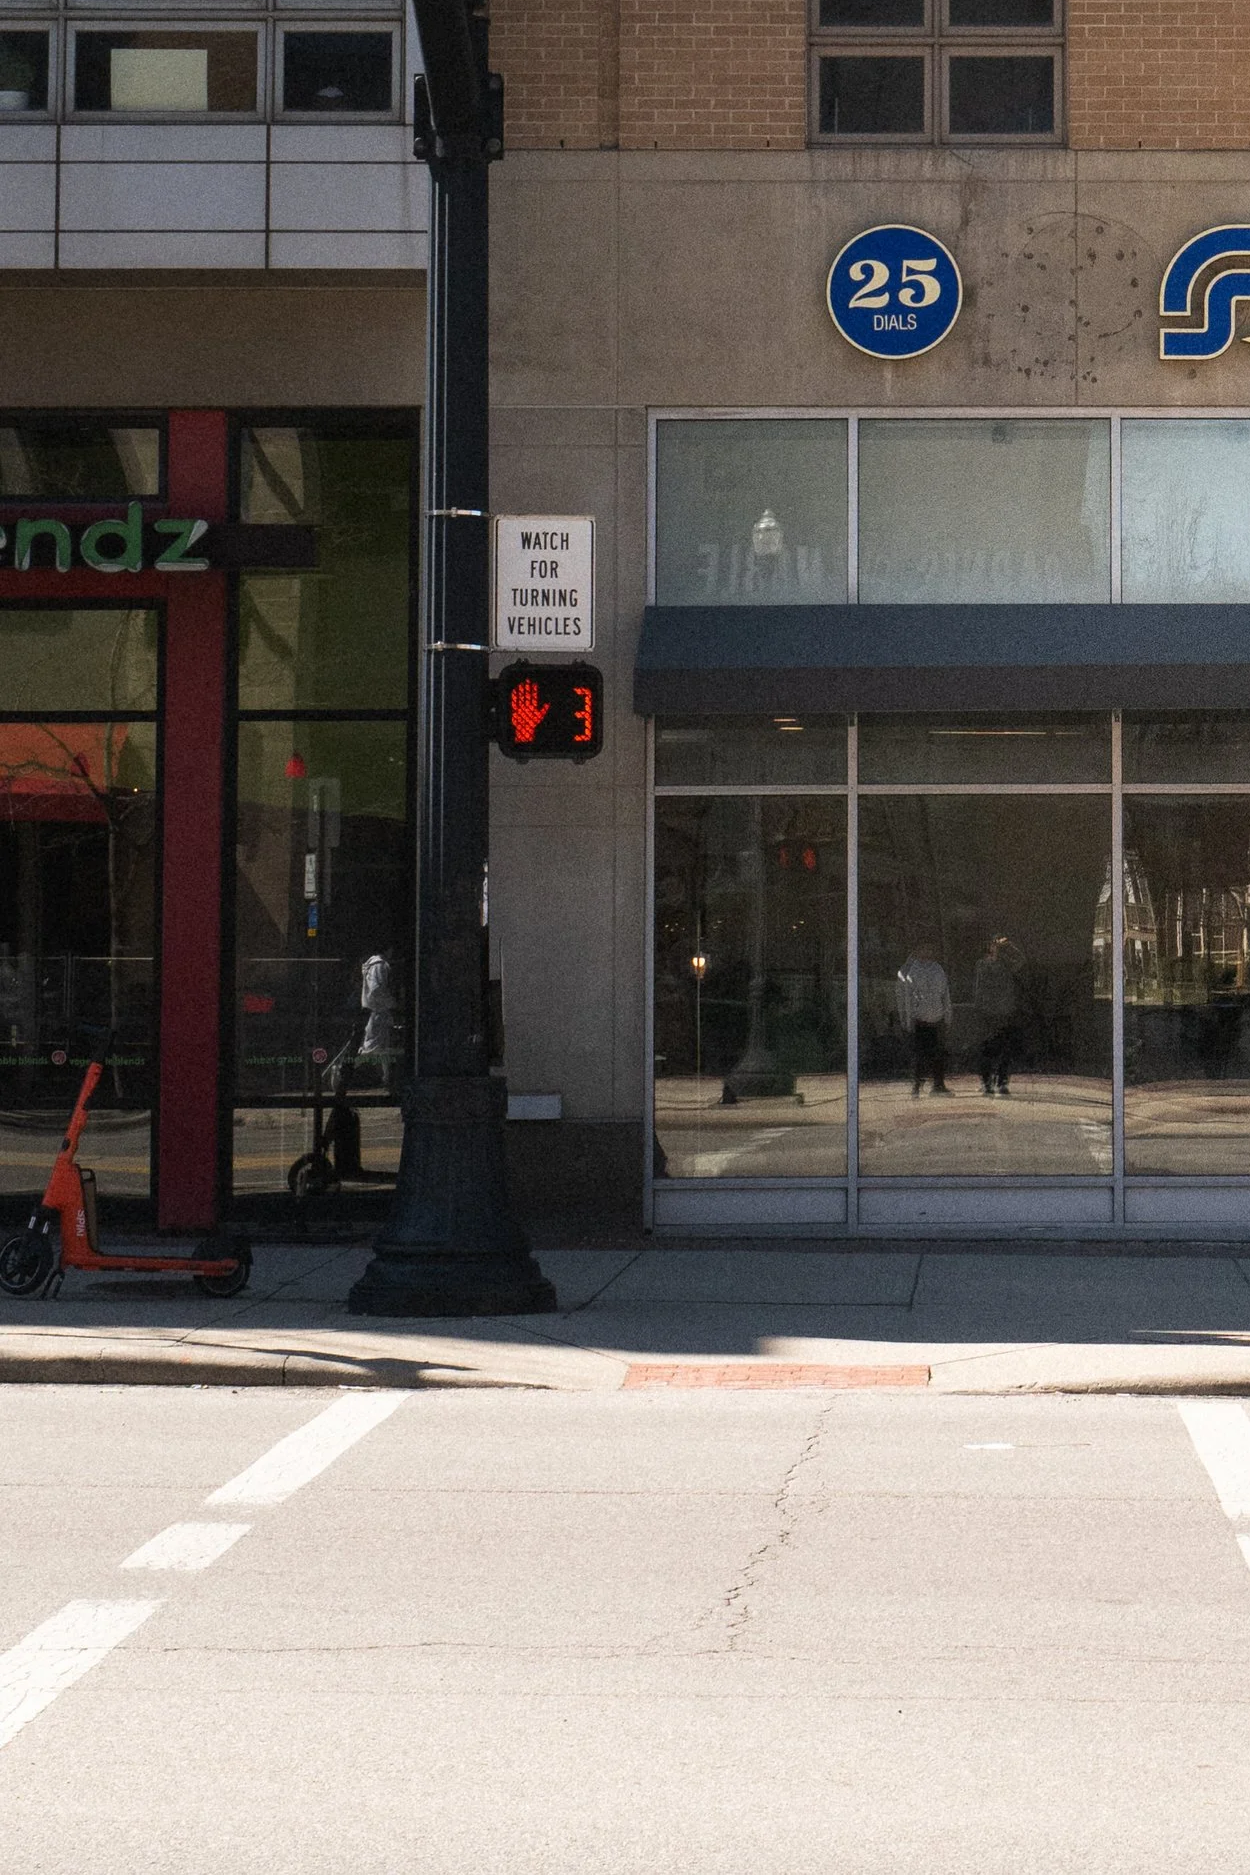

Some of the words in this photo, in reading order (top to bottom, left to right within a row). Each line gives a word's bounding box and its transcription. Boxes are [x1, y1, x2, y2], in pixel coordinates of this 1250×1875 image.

[848, 257, 942, 309] 25
[873, 313, 918, 332] DIALS
[0, 500, 210, 574] ndz
[520, 531, 570, 551] WATCH
[530, 560, 560, 579] FOR
[511, 588, 579, 608] TURNING
[507, 616, 582, 636] VEHICLES
[573, 686, 593, 743] 3
